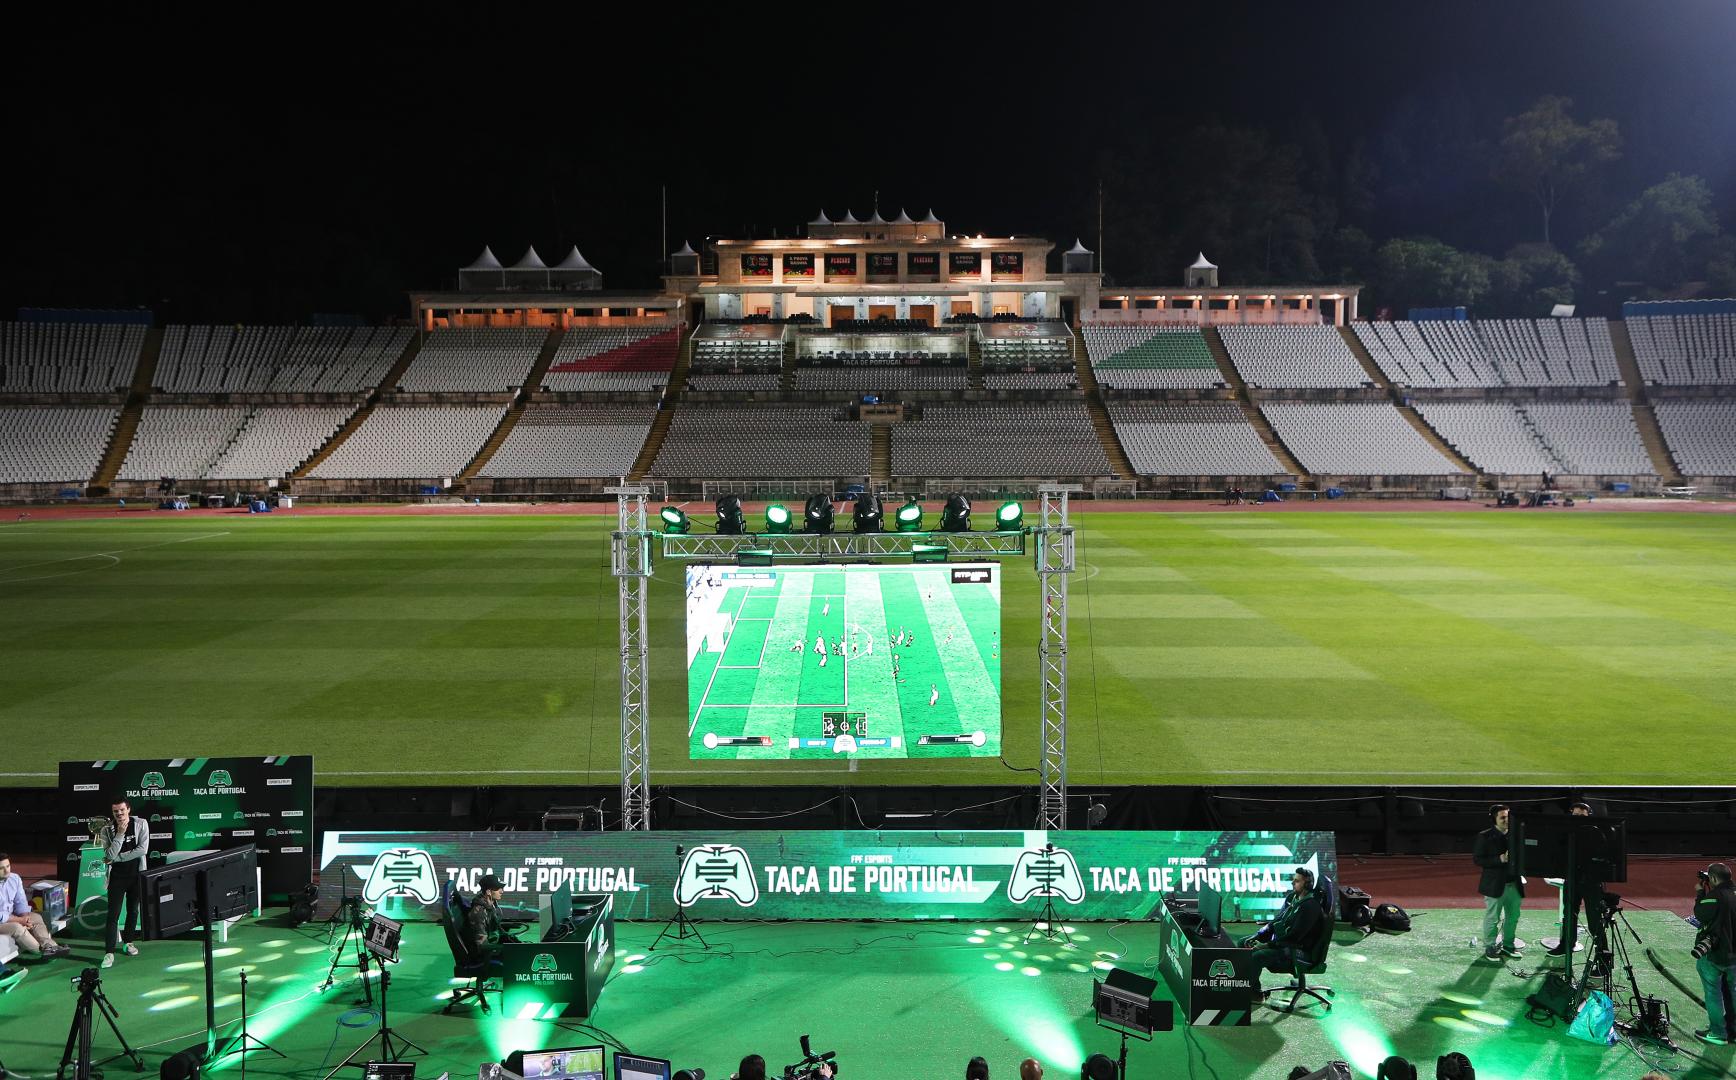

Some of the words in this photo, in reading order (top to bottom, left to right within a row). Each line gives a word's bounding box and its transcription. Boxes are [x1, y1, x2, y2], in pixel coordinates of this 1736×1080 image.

[446, 867, 496, 894] TAÇ
[503, 867, 530, 892] DE
[536, 867, 640, 892] PORTUGAL
[764, 866, 820, 895] TAÇA
[828, 866, 857, 892] DE
[864, 866, 980, 893] PORTUGAL
[1089, 867, 1141, 894] TAÇA
[1148, 867, 1174, 892] DE
[1181, 867, 1292, 893] PORTUGAL
[515, 973, 530, 982] TAÇA
[532, 973, 540, 981] DE
[542, 973, 573, 981] PORTUGAL
[1192, 979, 1208, 987] TAÇA
[1220, 979, 1251, 987] PORTUGAL
